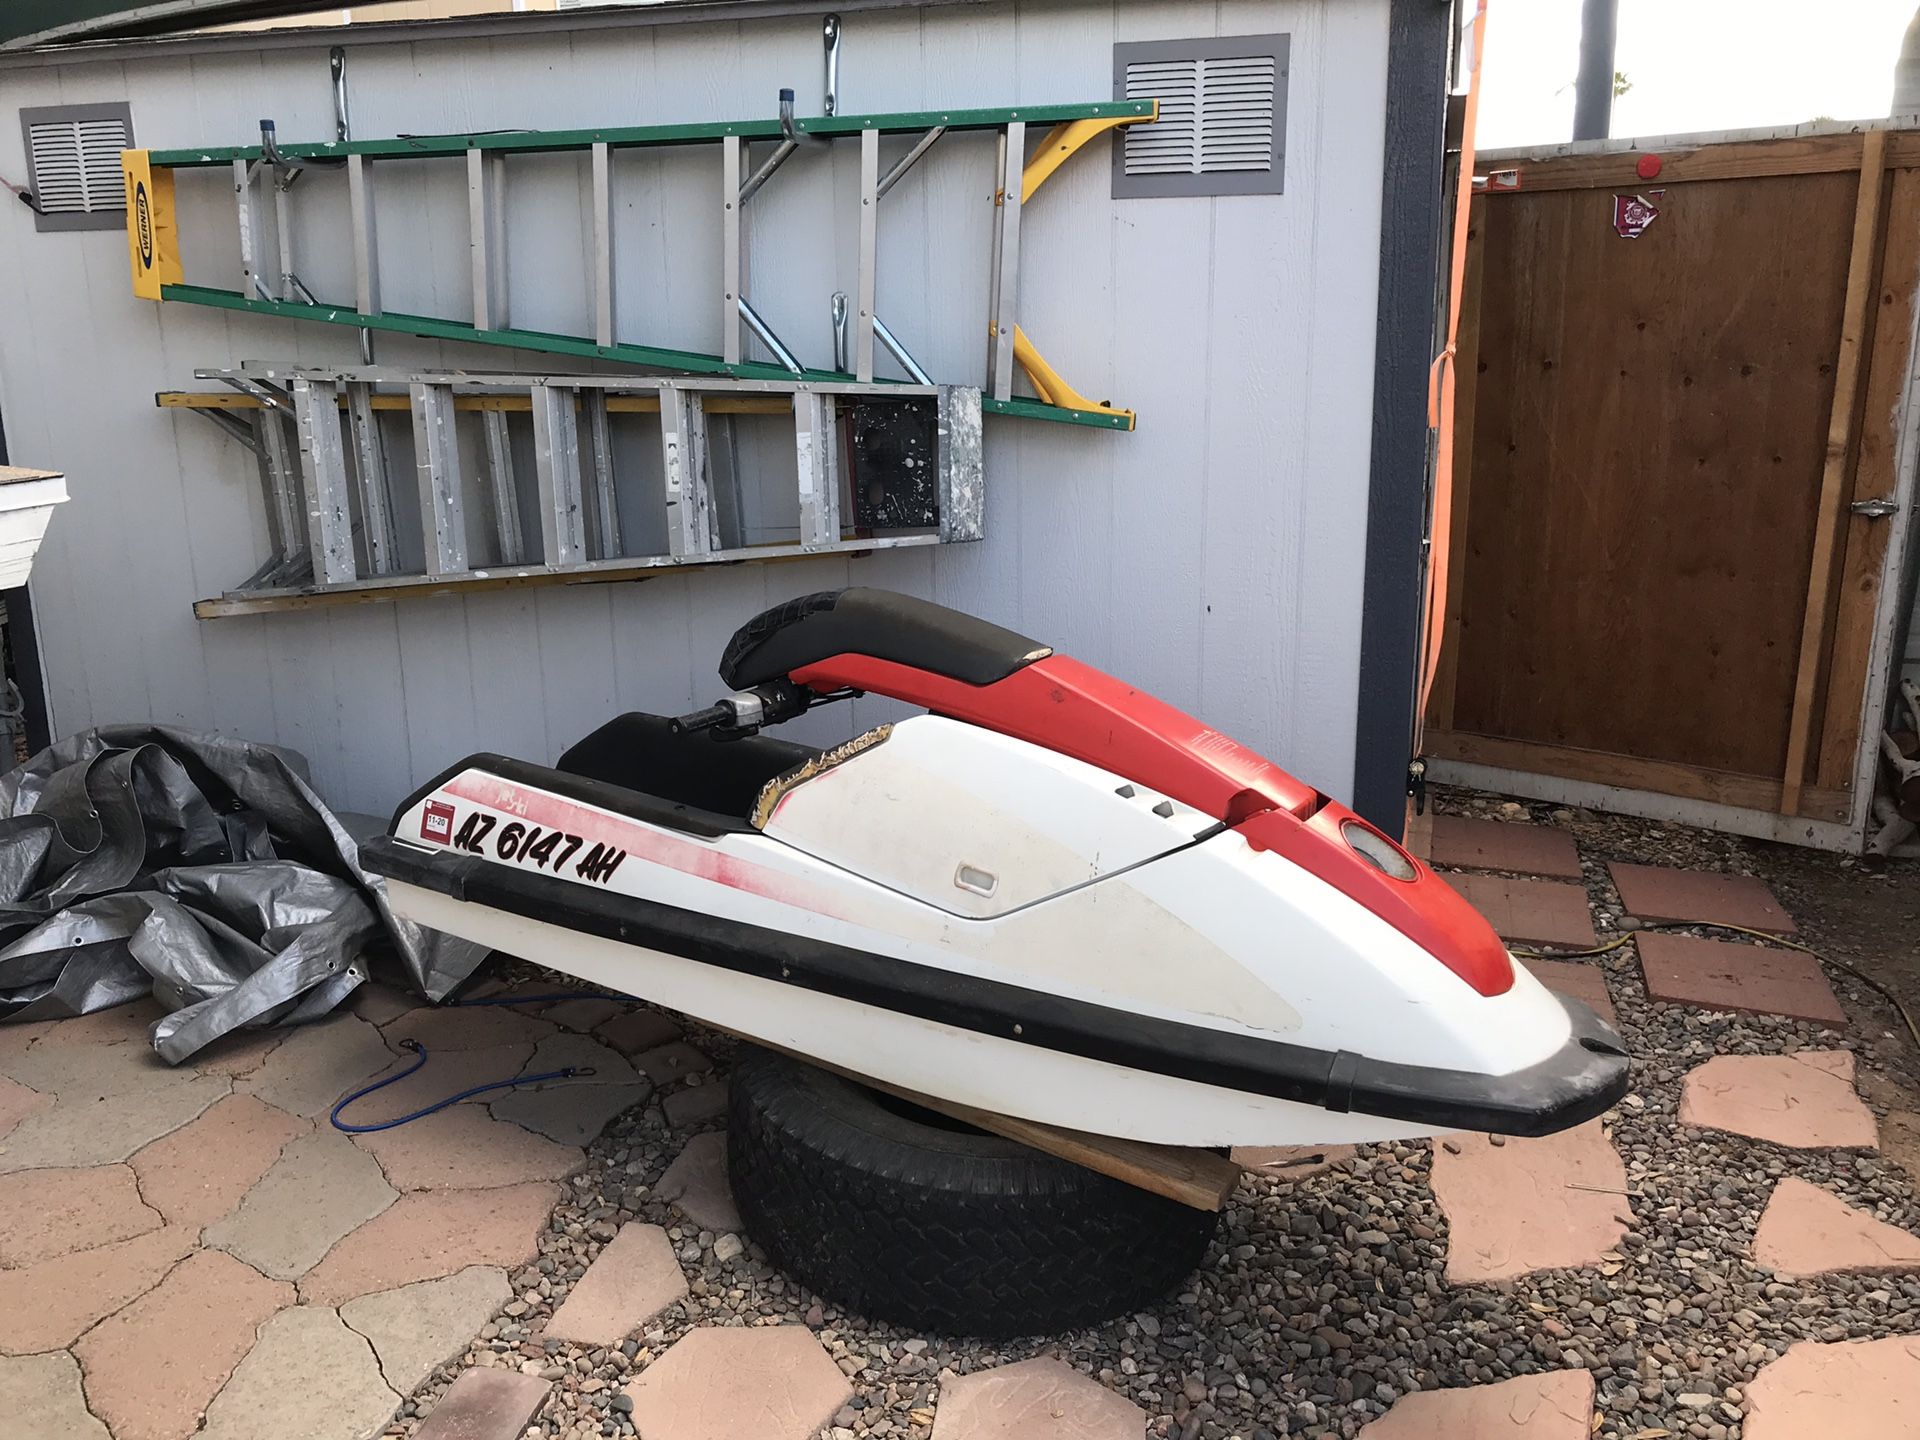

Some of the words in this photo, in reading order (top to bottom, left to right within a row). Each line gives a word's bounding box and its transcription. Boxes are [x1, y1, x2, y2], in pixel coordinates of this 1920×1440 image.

[138, 199, 150, 251] WERNER
[428, 815, 446, 827] 11-20
[454, 811, 497, 855] AZ
[497, 821, 583, 873] 6147
[576, 842, 627, 884] AH
